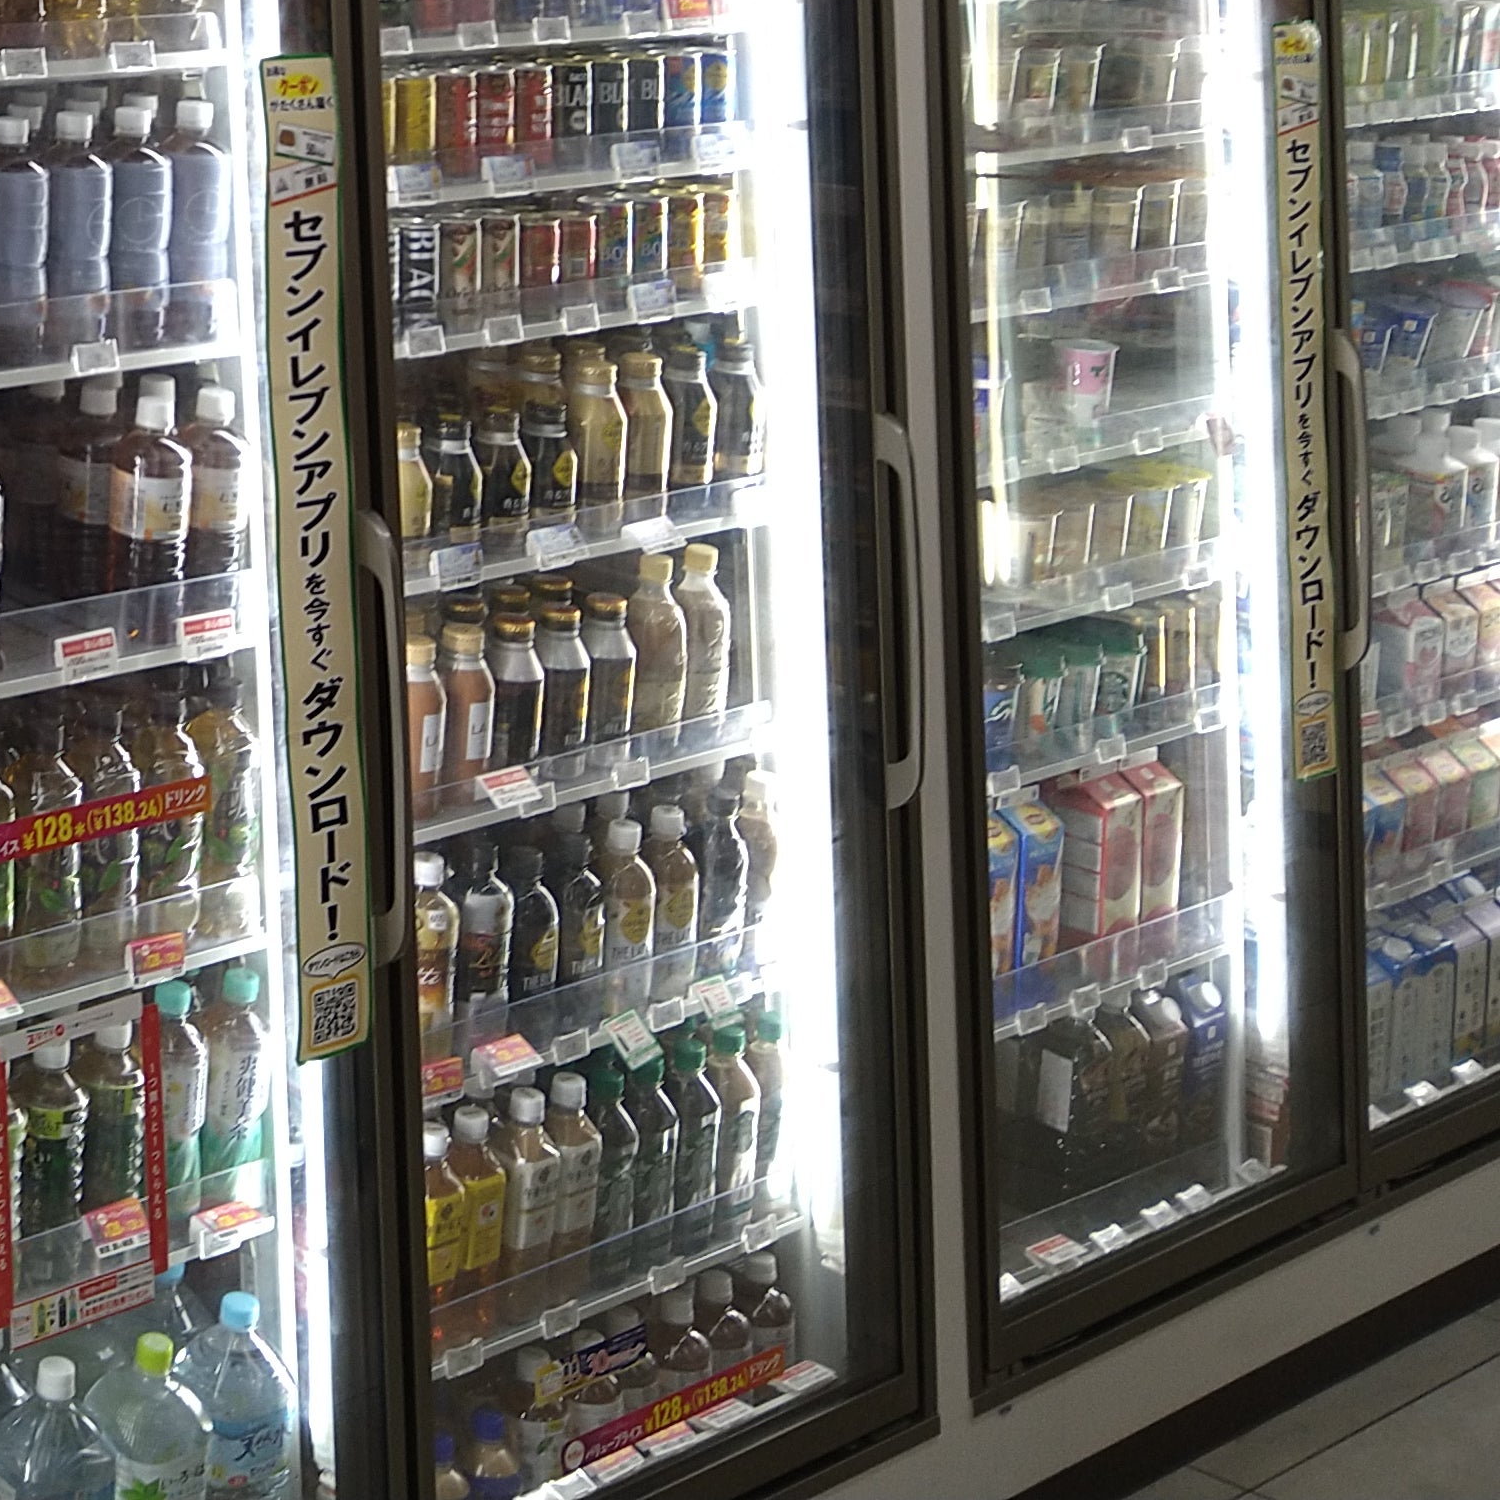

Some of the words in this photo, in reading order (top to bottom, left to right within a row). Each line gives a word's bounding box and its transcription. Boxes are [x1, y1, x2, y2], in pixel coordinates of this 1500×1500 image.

[279, 75, 320, 97] クーポン
[163, 783, 207, 811] ドリンク
